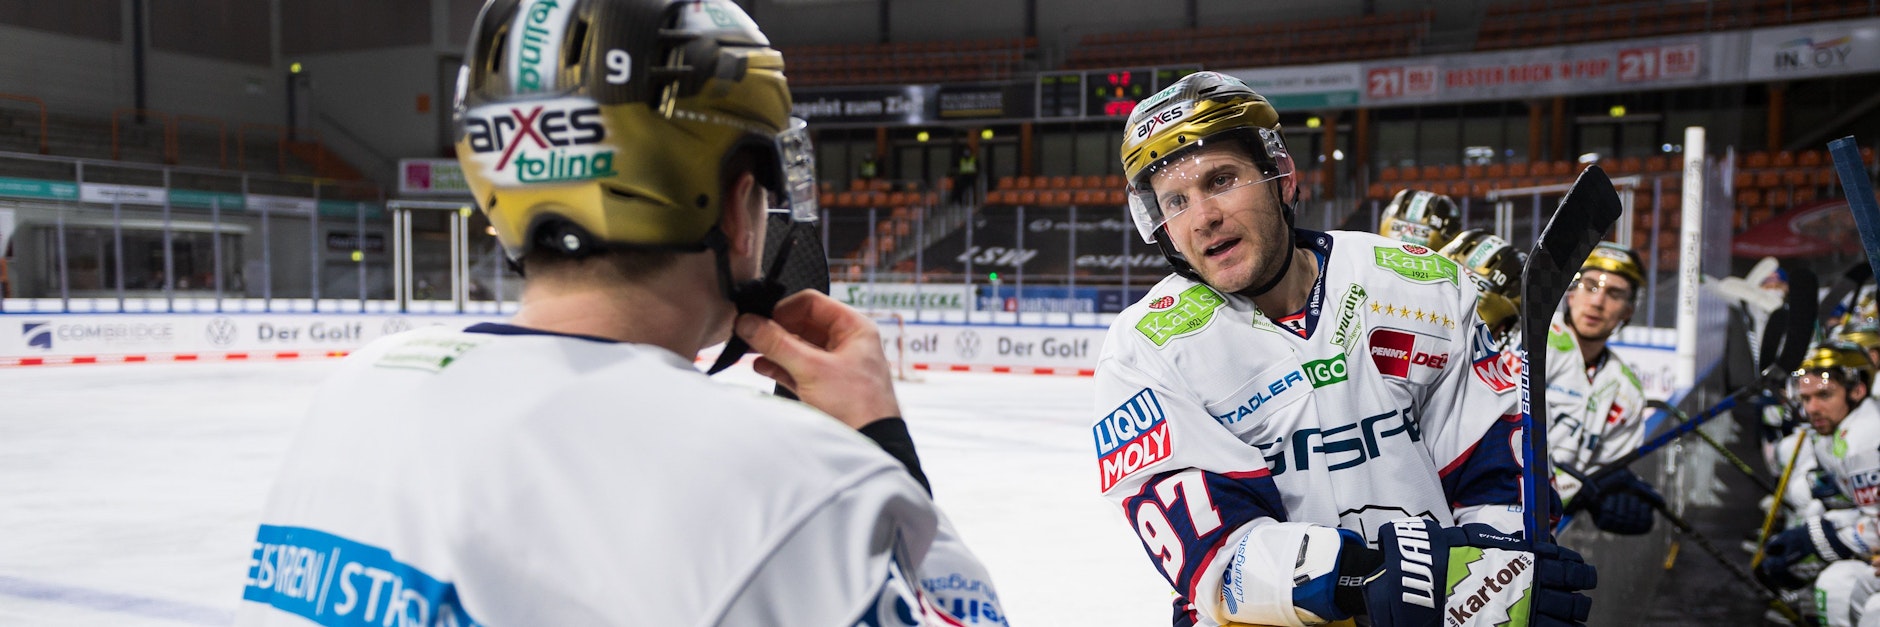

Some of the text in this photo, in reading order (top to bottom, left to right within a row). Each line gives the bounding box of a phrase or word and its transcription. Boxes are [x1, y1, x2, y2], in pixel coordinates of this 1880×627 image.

[606, 50, 632, 84] 9
[513, 149, 618, 183] tolina
[1381, 251, 1454, 280] Karls
[1411, 270, 1429, 279] 1921
[1492, 269, 1507, 286] 10
[1143, 290, 1217, 341] Karls
[1186, 318, 1203, 330] 1921
[258, 323, 362, 342] Der Golf
[998, 337, 1088, 358] Der Golf
[1100, 391, 1160, 453] LIQUI
[1102, 422, 1168, 489] MOLY
[1136, 469, 1223, 586] 97
